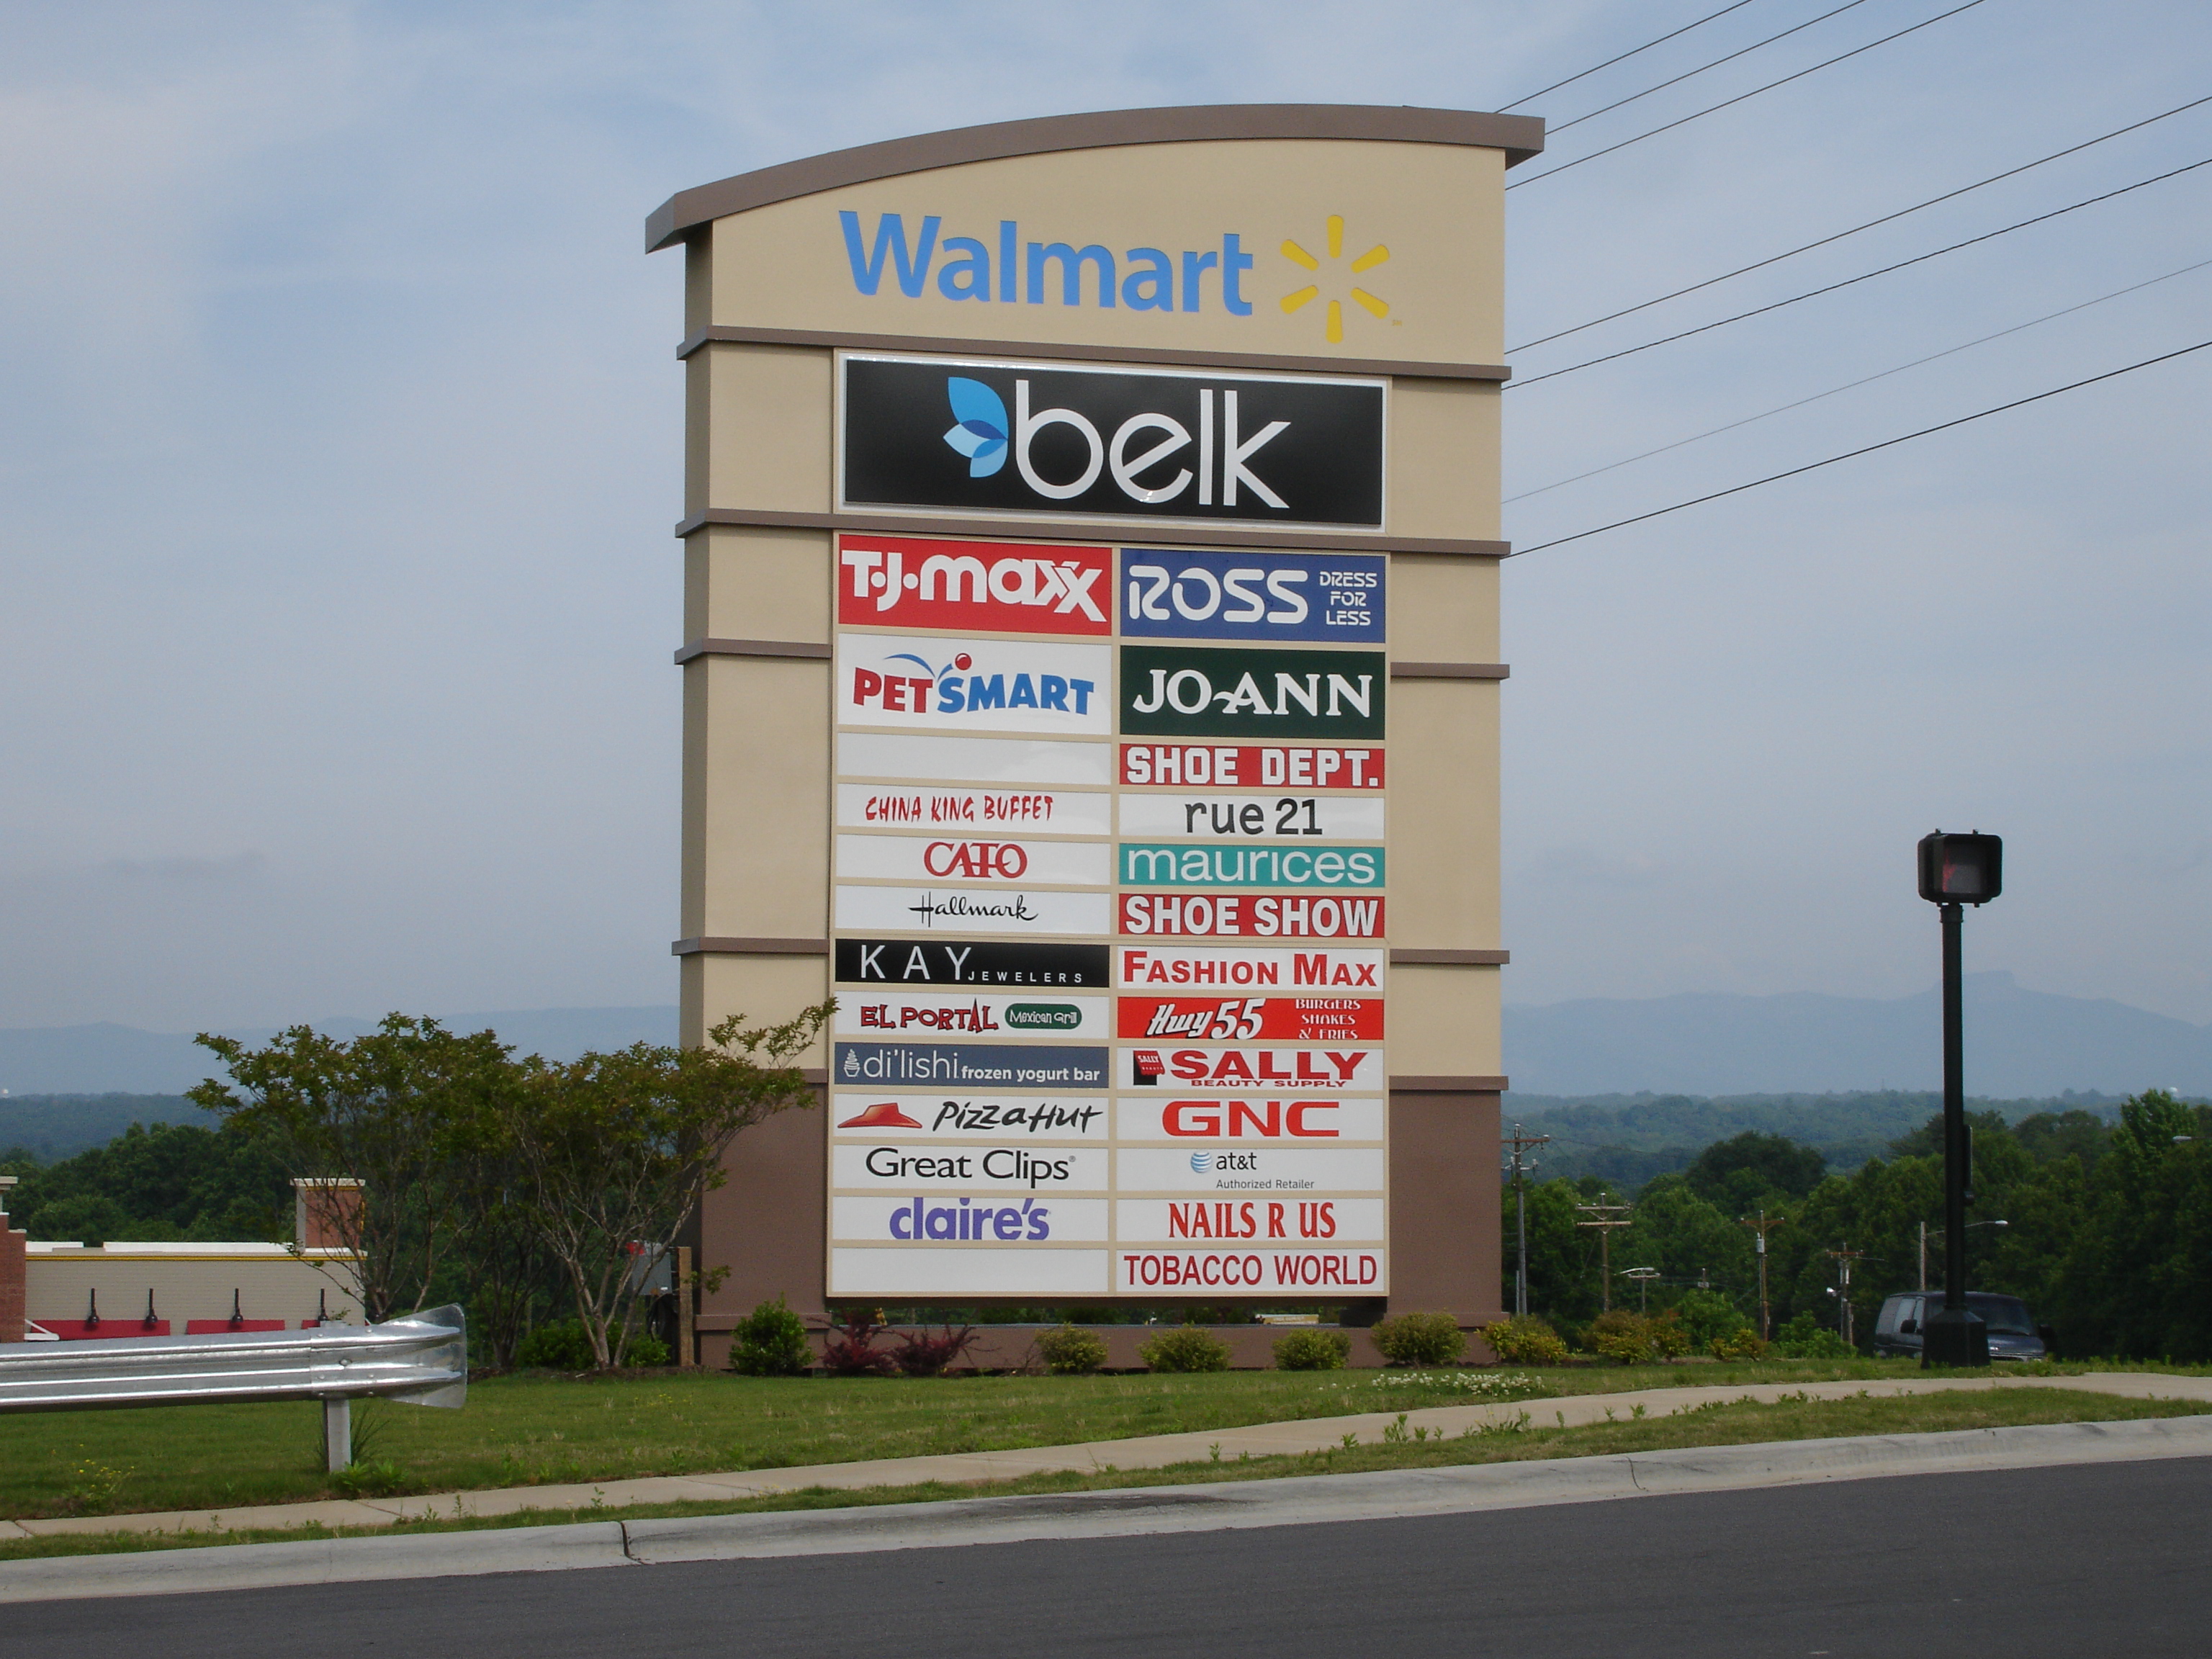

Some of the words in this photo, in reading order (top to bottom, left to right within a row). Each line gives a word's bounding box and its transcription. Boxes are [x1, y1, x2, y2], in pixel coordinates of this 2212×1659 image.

[838, 210, 1253, 316] Walmart
[1016, 379, 1291, 508] belk
[1129, 565, 1308, 624] ROSS
[1319, 571, 1377, 588] DRESS
[1330, 591, 1367, 606] FOR
[1326, 611, 1371, 626] LESS
[1126, 747, 1238, 785] SHOE
[1262, 749, 1378, 786] DEPT.
[865, 796, 922, 822] CHINA
[931, 796, 975, 822] KING
[984, 795, 1053, 822] BUFFET
[1184, 802, 1264, 834] rue
[1275, 798, 1323, 835] 21
[923, 842, 1028, 878] CATO
[1128, 849, 1375, 884] maurices
[907, 891, 1039, 927] Hallmark
[1125, 896, 1239, 935] SHOE
[1254, 897, 1378, 936] SHOW
[860, 944, 971, 981] KAY
[968, 971, 1082, 983] JEWELERS
[1123, 950, 1278, 985] FASHION
[1293, 953, 1377, 987] MAX
[860, 1004, 896, 1029] EL
[899, 998, 999, 1033] PORTAL
[1010, 1010, 1052, 1024] Mexican
[1053, 1012, 1077, 1024] Grill
[1146, 1003, 1213, 1038] Hwy
[1210, 998, 1266, 1040] 55
[1295, 999, 1361, 1010] BURGERS
[1301, 1014, 1356, 1025] SHAKES
[1319, 1029, 1359, 1039] FRIES
[863, 1048, 959, 1079] di'lishi
[961, 1066, 1012, 1080] frozen
[1017, 1067, 1069, 1082] yogurt
[1074, 1067, 1100, 1081] bar
[1170, 1050, 1368, 1080] SALLY
[1162, 1101, 1339, 1137] GNC
[866, 1147, 972, 1179] Great
[1216, 1152, 1256, 1170] at&t
[1216, 1179, 1272, 1189] Authorized
[1276, 1179, 1314, 1189] Retailer
[889, 1197, 1050, 1240] claire's
[1169, 1202, 1256, 1238] NAILS
[1268, 1203, 1286, 1238] R
[1299, 1202, 1336, 1238] US
[1124, 1255, 1262, 1285] TOBACCO
[1274, 1255, 1377, 1285] WORLD
